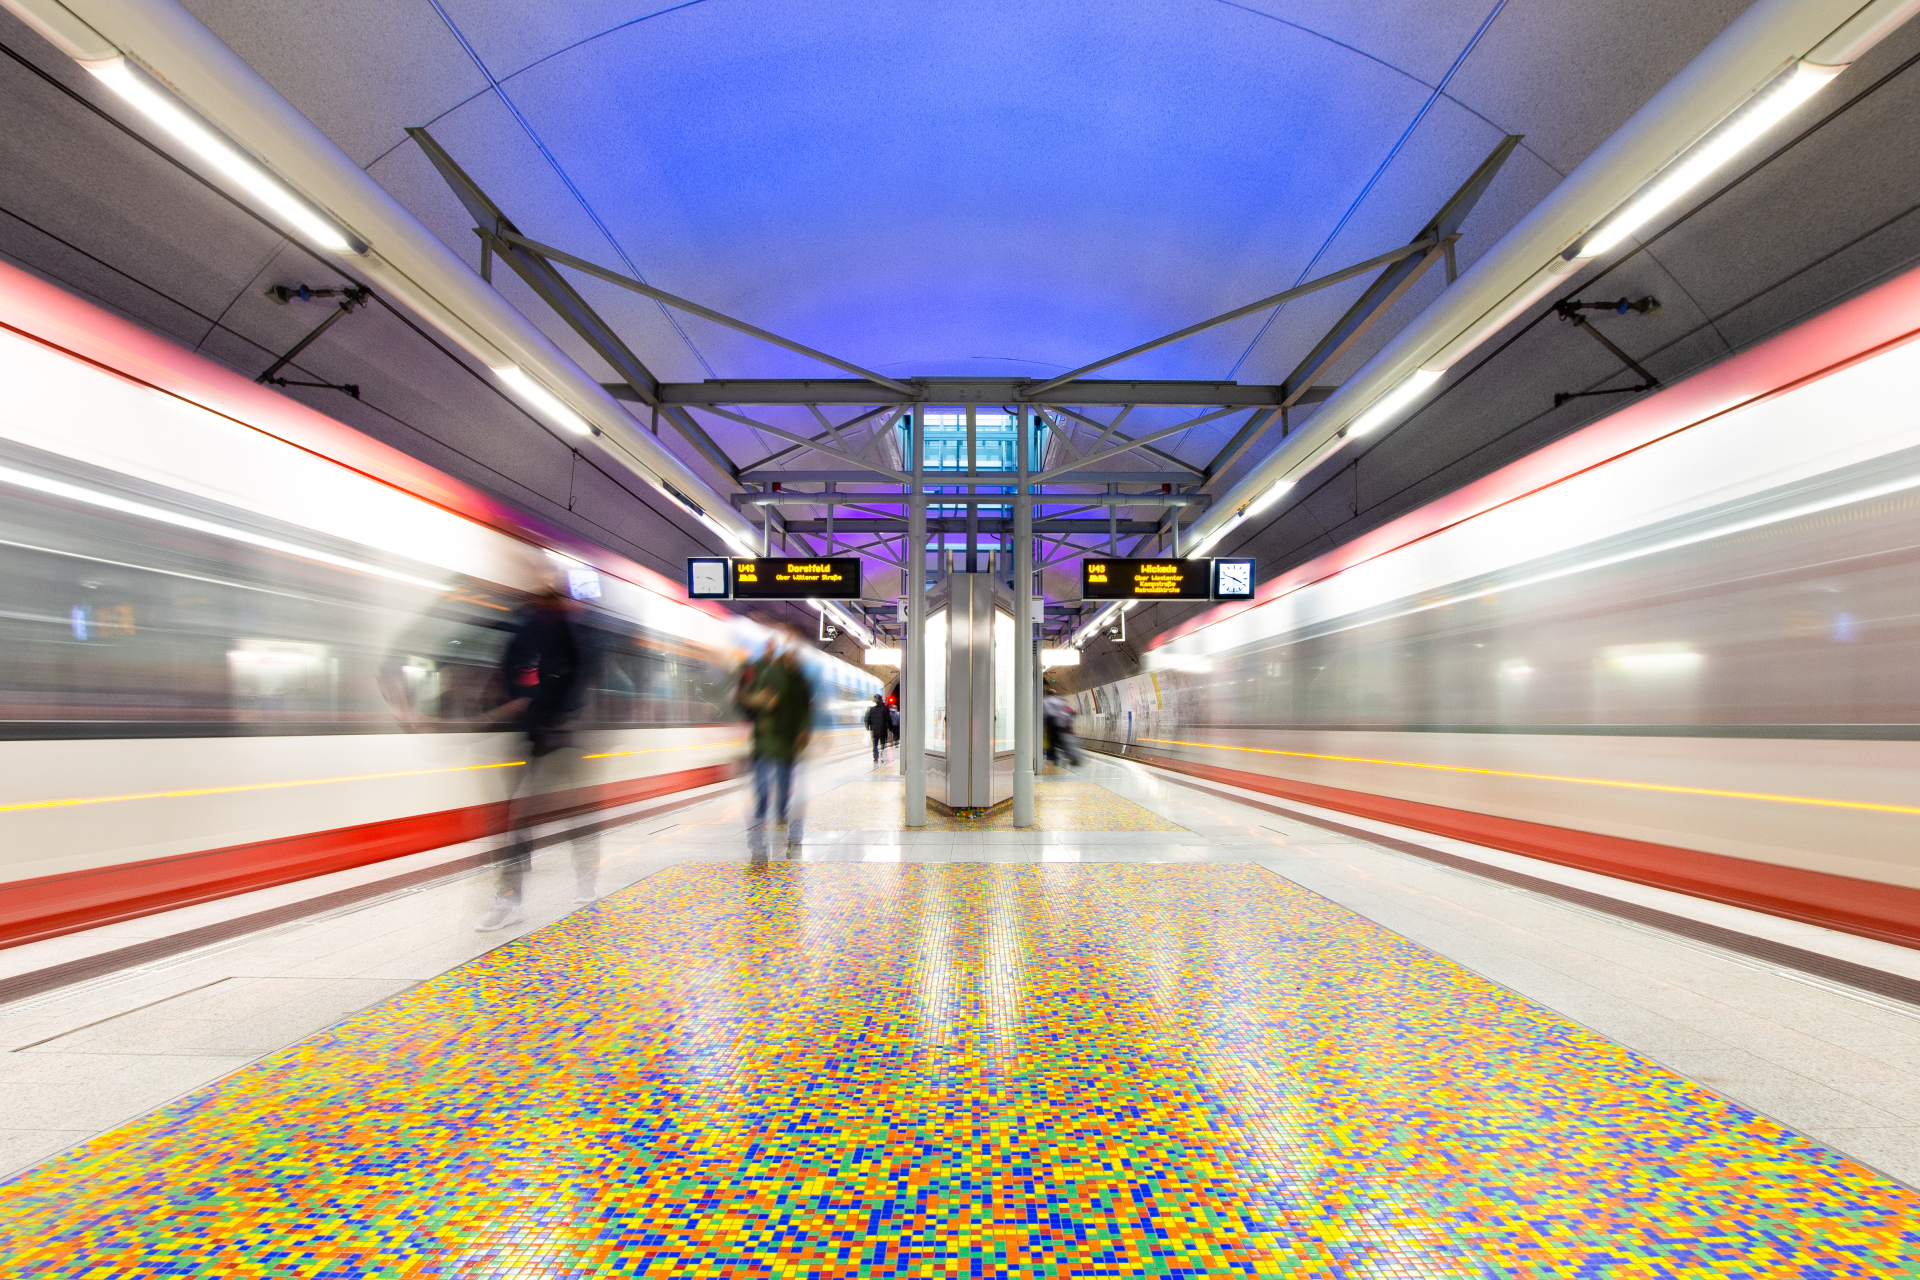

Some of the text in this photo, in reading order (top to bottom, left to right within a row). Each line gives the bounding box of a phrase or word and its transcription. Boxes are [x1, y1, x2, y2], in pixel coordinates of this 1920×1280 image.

[738, 564, 755, 573] U43
[787, 564, 831, 573] Dorstfeld
[1088, 564, 1106, 573] U43
[1140, 564, 1178, 573] Wickede
